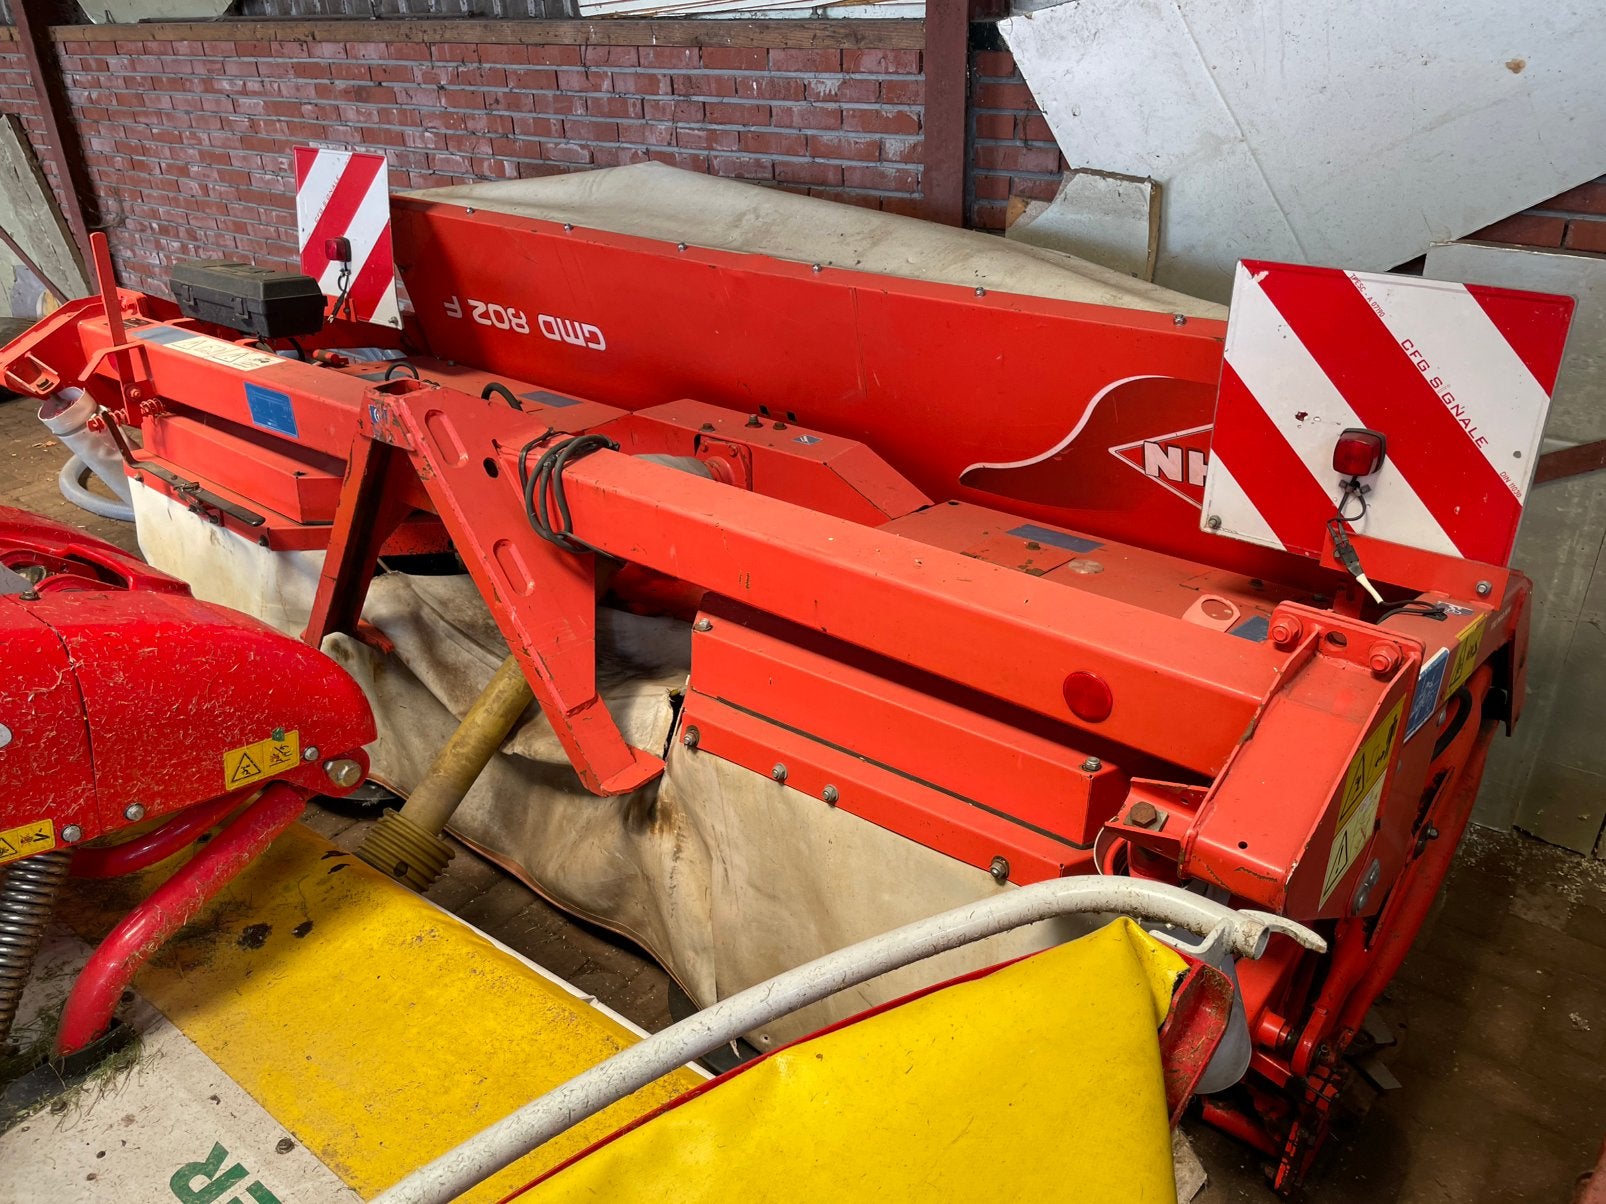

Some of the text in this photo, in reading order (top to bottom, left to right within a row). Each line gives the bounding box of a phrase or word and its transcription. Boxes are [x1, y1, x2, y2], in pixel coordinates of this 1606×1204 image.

[443, 295, 607, 351] GMD 802 F
[1401, 339, 1488, 448] CFG SGNALE
[1500, 471, 1511, 483] DIN
